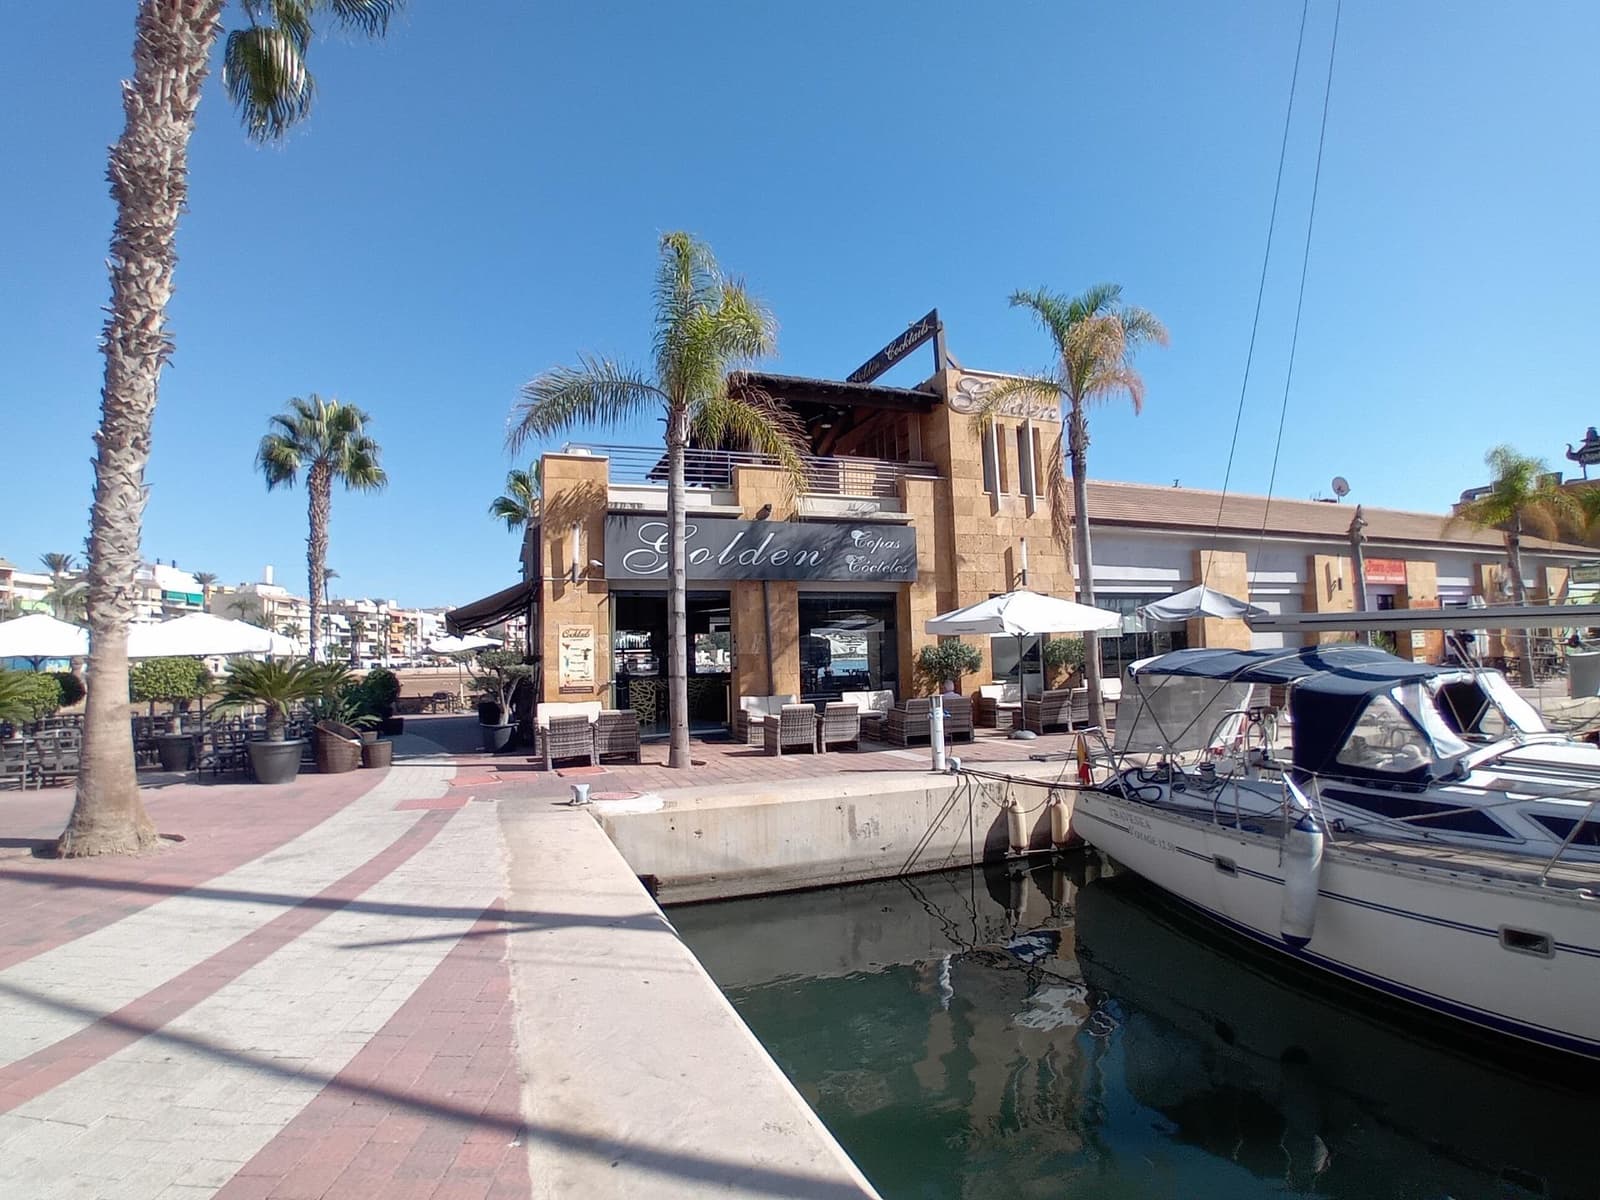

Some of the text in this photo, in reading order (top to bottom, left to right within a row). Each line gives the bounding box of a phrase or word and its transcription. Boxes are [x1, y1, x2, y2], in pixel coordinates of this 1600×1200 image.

[622, 522, 824, 575] Golden
[851, 529, 901, 554] Copas
[845, 554, 908, 573] Cócteles
